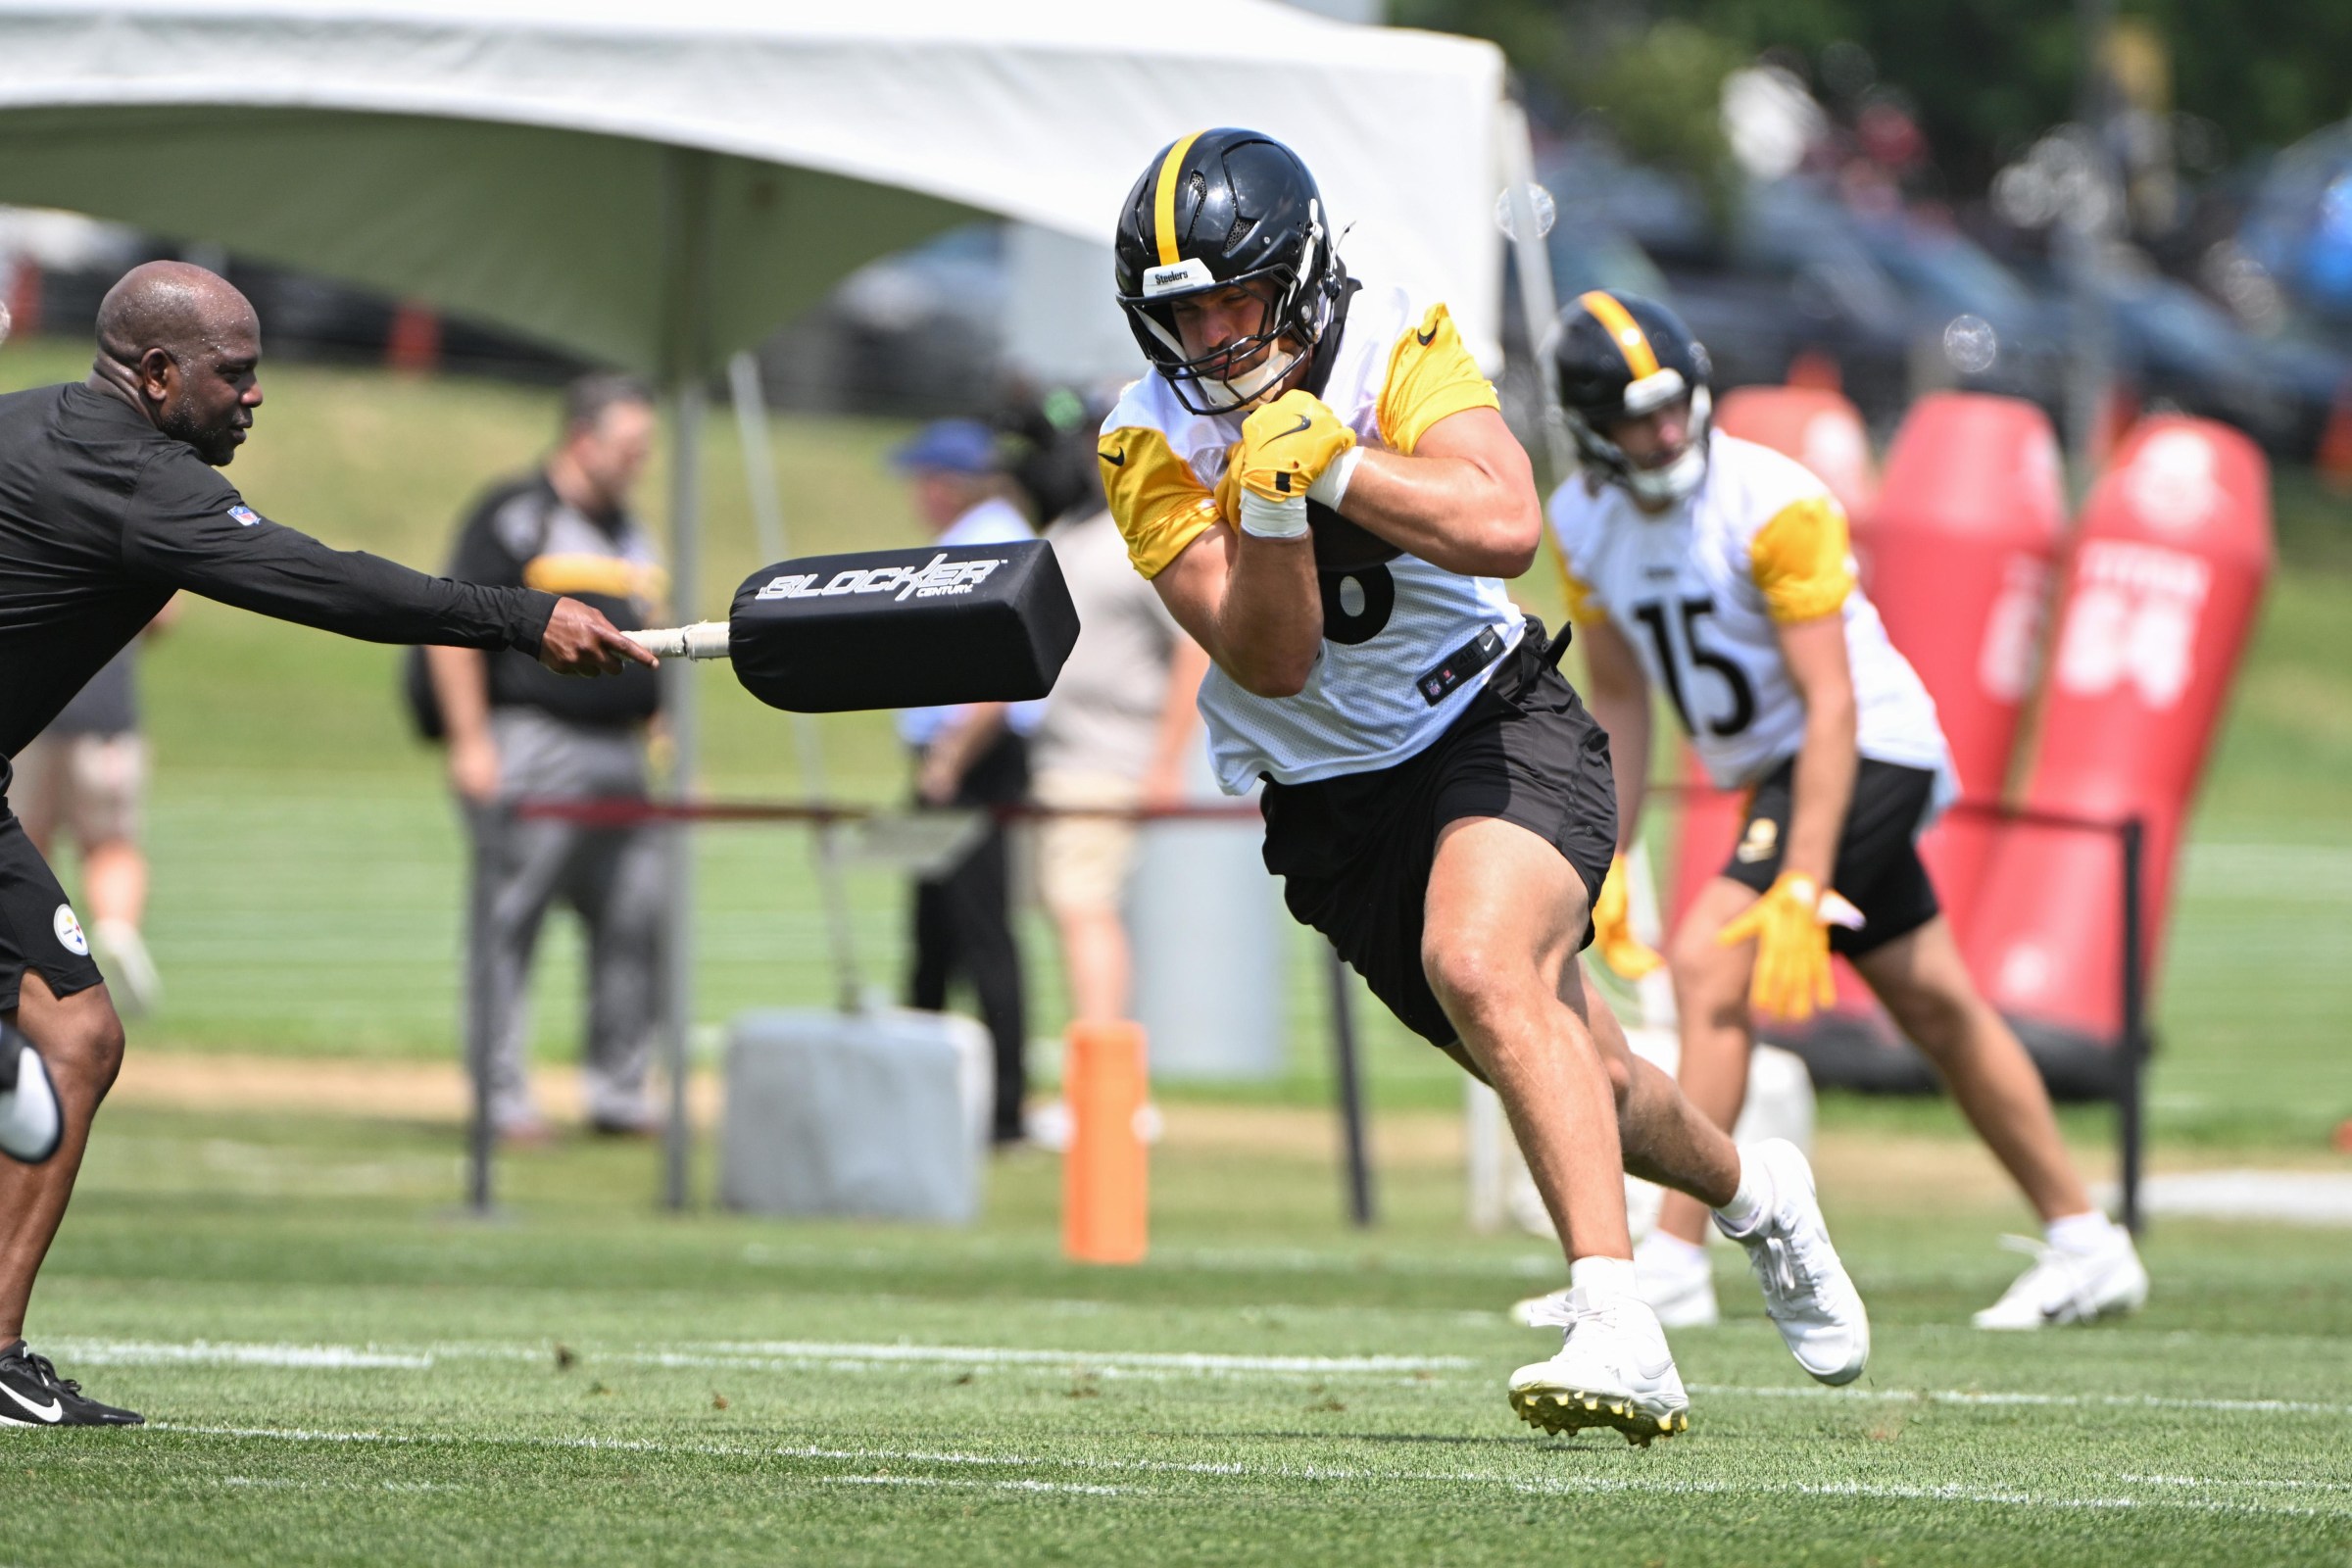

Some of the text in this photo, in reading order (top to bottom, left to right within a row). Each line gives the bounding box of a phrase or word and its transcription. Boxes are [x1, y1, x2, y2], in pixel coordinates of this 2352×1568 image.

[1154, 270, 1189, 285] Steelers
[755, 553, 1000, 602] BLOCKER
[916, 583, 973, 598] CENTURY
[1633, 596, 1755, 737] 15
